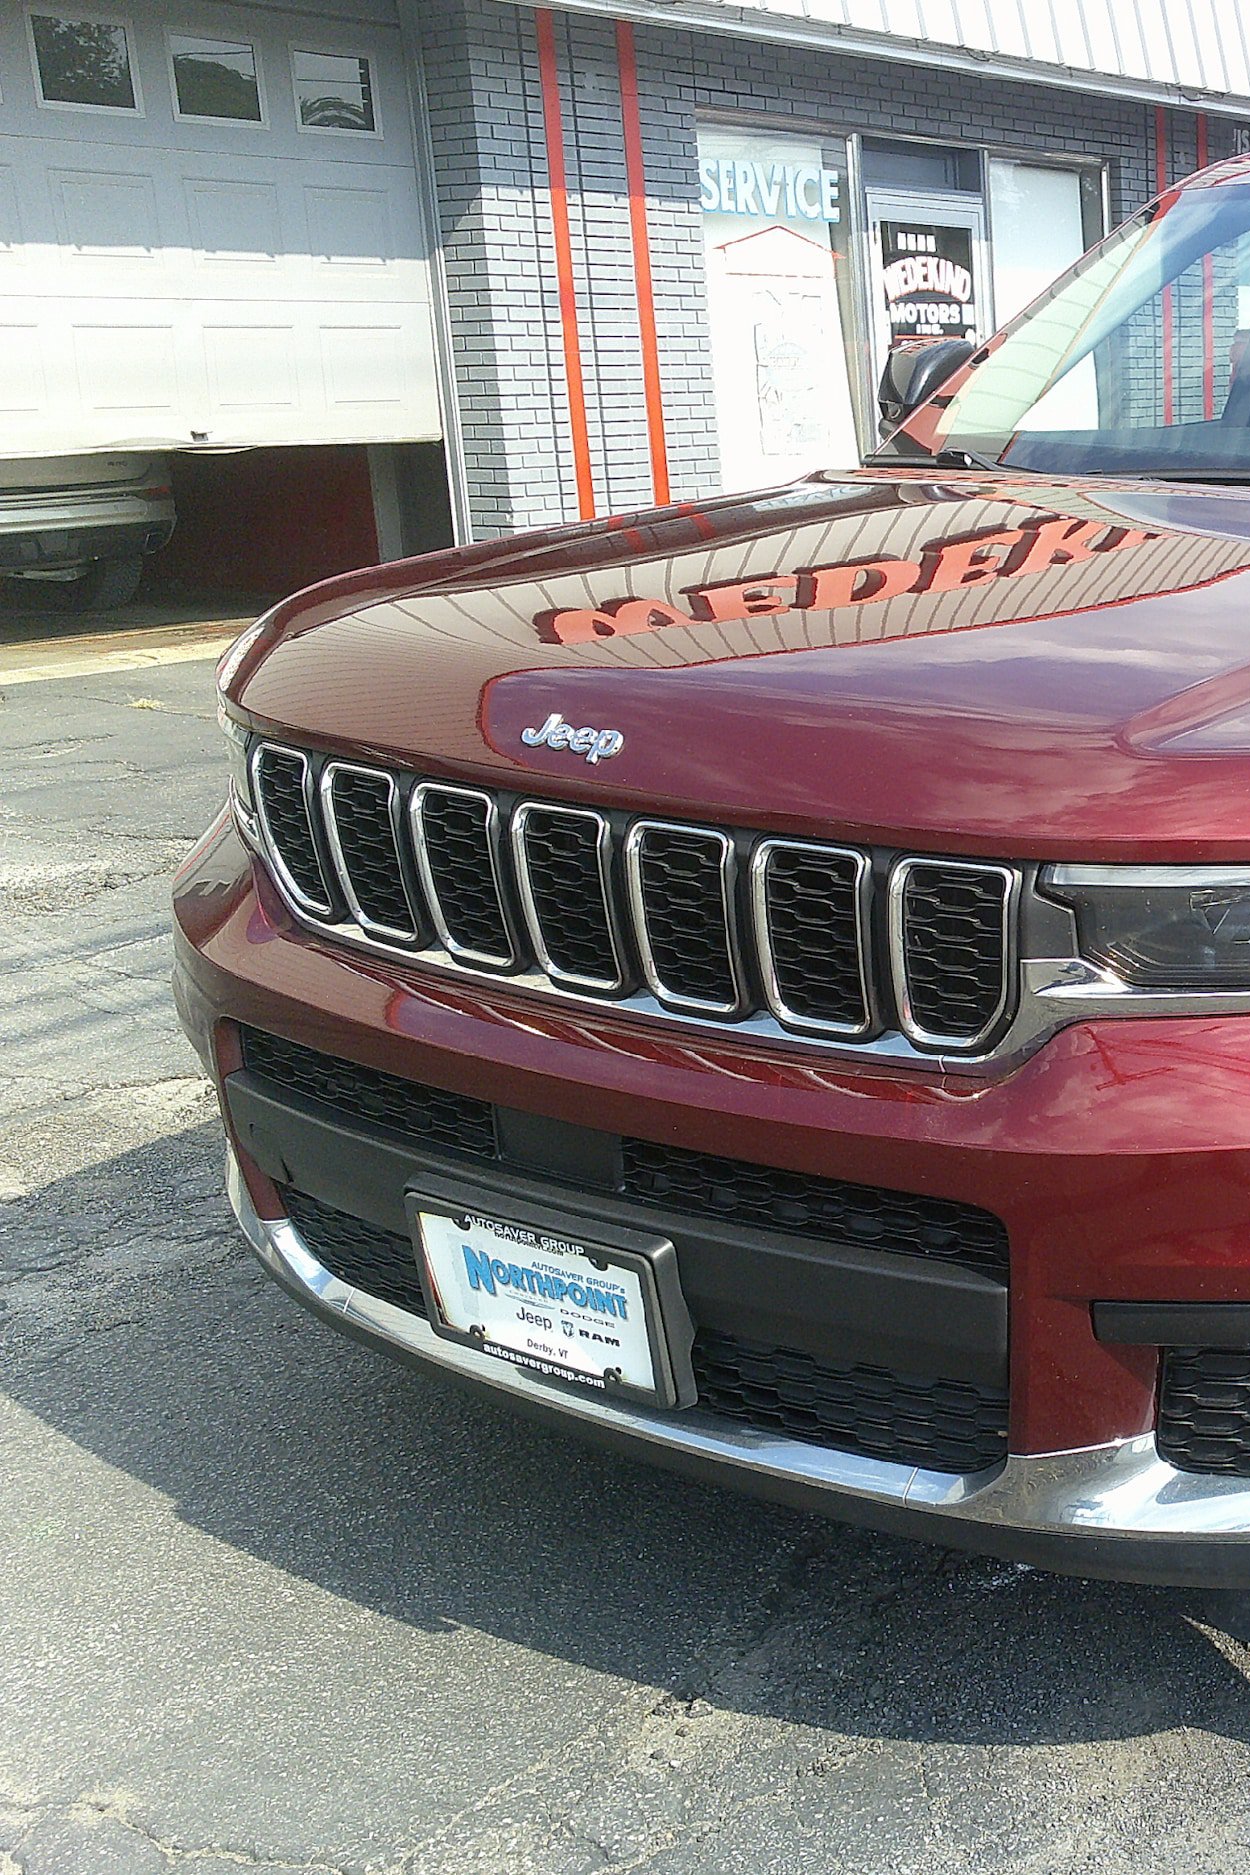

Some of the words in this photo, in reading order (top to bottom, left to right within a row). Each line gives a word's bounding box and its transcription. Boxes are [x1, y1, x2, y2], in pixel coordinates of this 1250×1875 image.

[699, 159, 840, 223] SERVICE
[881, 255, 971, 302] WEDEKIND
[889, 302, 961, 324] MOTORS
[521, 713, 625, 765] Jeep
[464, 1214, 536, 1245] AUTOSAVER
[540, 1236, 585, 1257] GROUP
[531, 1261, 584, 1284] AUTOSAVER
[516, 1306, 552, 1331] Jeep
[560, 1308, 616, 1329] DODGE
[579, 1328, 621, 1348] RAM
[483, 1343, 606, 1389] autosavergroup.com
